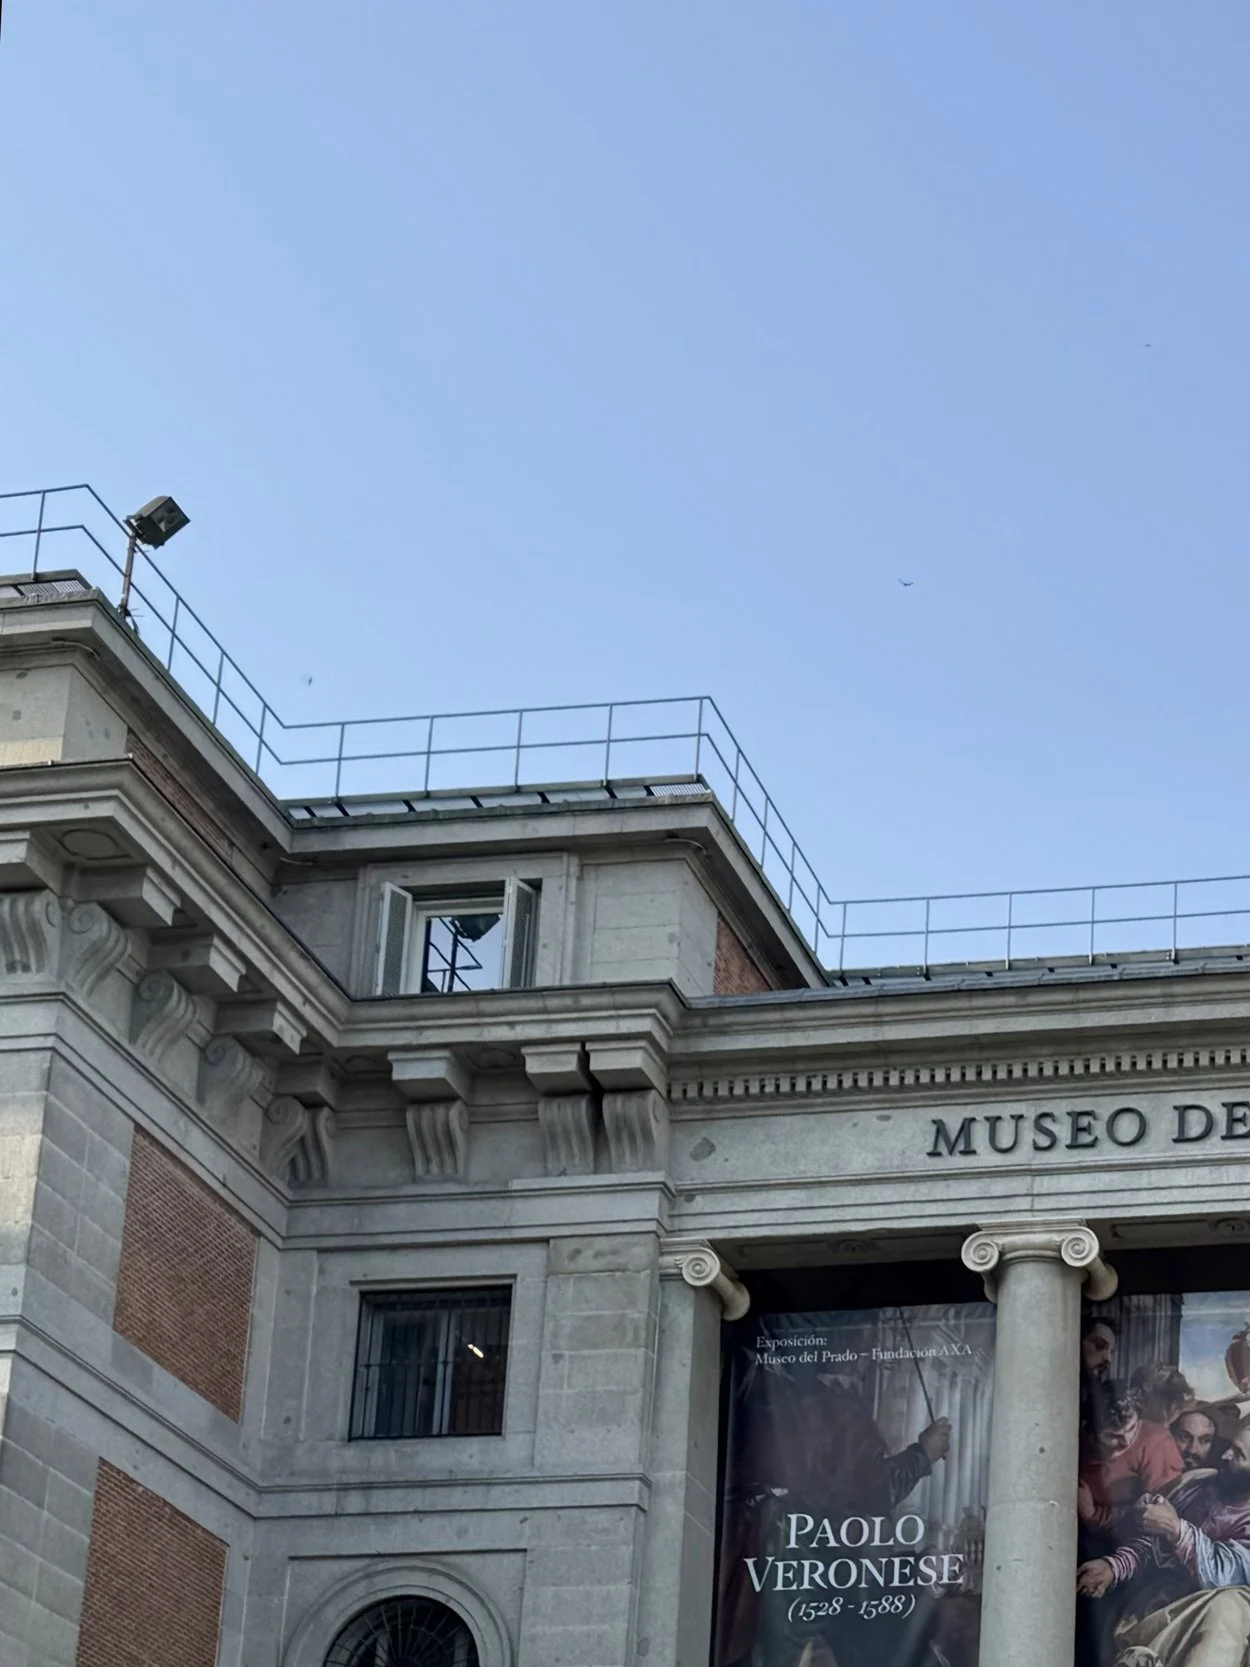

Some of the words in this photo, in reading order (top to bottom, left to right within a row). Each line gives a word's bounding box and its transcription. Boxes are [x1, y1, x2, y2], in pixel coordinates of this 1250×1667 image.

[926, 1106, 1148, 1157] MUSEO
[755, 1353, 796, 1366] Museo
[799, 1351, 819, 1364] del
[821, 1350, 858, 1363] Prado
[938, 1343, 973, 1357] AXA
[756, 1334, 828, 1351] Exposición:
[785, 1513, 925, 1549] PAOLO
[743, 1553, 964, 1593] VERONESE
[787, 1596, 844, 1623] (1528
[858, 1593, 916, 1620] 1588)
